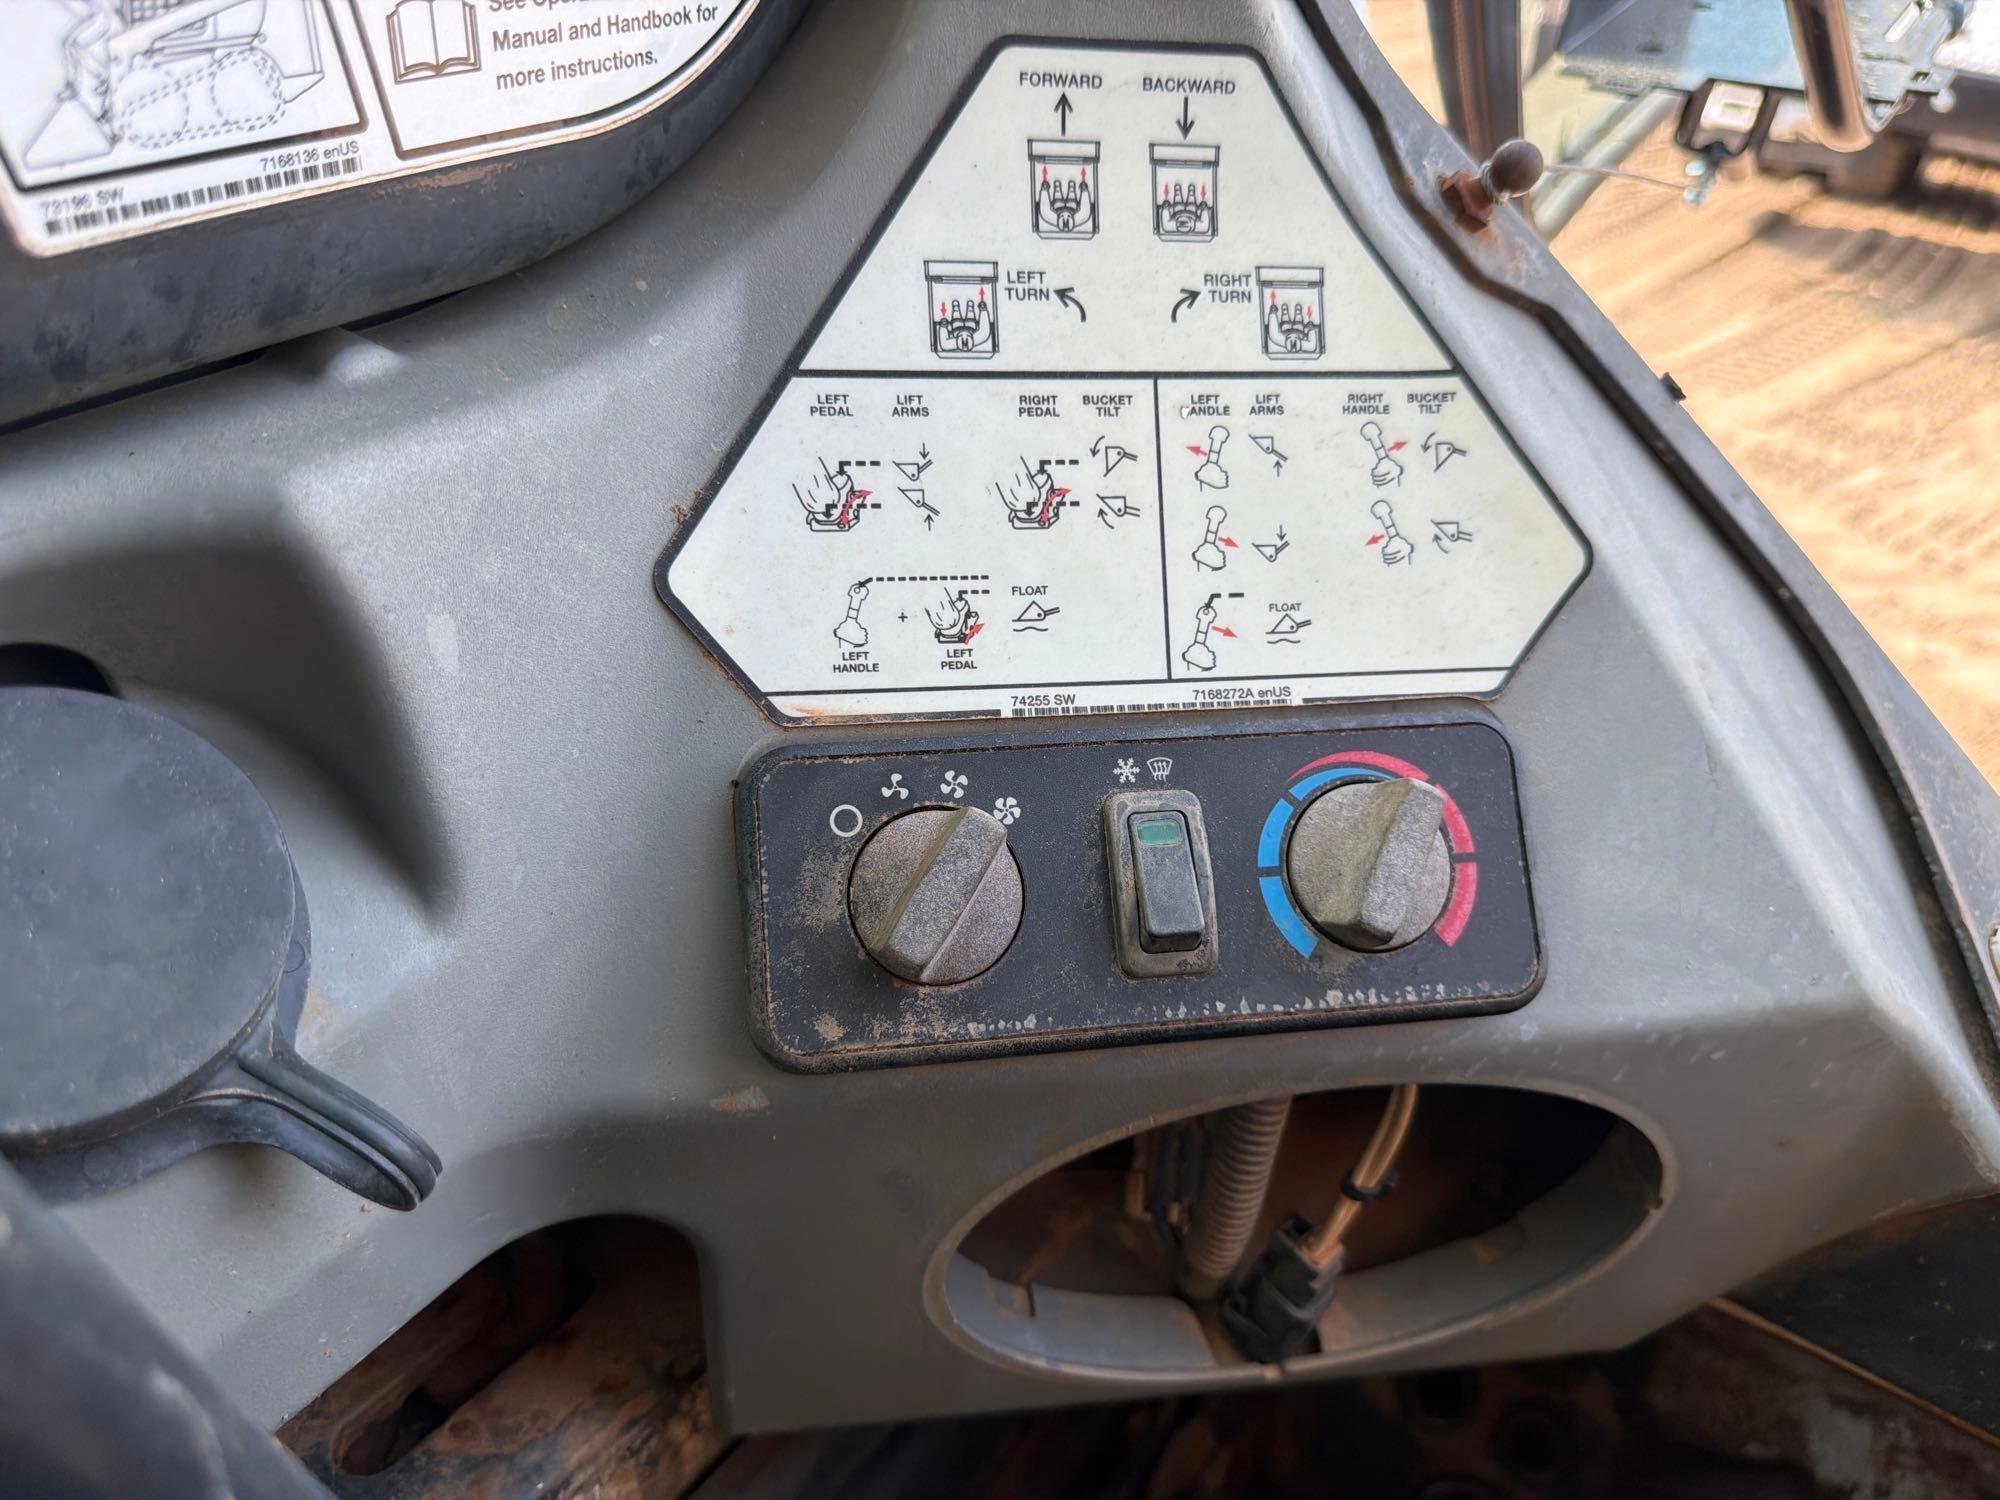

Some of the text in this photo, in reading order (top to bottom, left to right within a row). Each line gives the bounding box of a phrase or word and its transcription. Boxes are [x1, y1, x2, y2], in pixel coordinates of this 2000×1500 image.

[492, 4, 718, 52] Manual and Handbook for
[496, 49, 659, 90] more instructions.
[1019, 72, 1103, 89] FORWARD
[1142, 77, 1235, 95] BACKWARD
[260, 140, 359, 171] 7168136 enUS
[1007, 271, 1046, 284] LEFT
[1204, 274, 1251, 287] RIGHT
[1005, 287, 1050, 301] TURN
[1208, 290, 1251, 303] TURN
[817, 394, 849, 405] LEFT
[897, 395, 923, 405] LIFT
[1019, 395, 1058, 406] RIGHT
[1082, 395, 1133, 406] BUCKET
[1191, 394, 1220, 404] LEFT
[1256, 394, 1280, 404] LIFT
[1347, 394, 1384, 404] RIGHT
[1407, 393, 1456, 404] BUCKET
[810, 406, 854, 417] PEDAL
[892, 406, 930, 418] ARMS
[1019, 407, 1060, 418] PEDAL
[1096, 406, 1121, 417] TILT
[1180, 406, 1230, 417] ANDLE
[1249, 406, 1284, 416] ARMS
[1342, 405, 1390, 415] HANDLE
[1419, 404, 1442, 414] TILT
[1012, 586, 1048, 596] FLOAT
[1269, 602, 1301, 612] FLOAT
[842, 652, 869, 661] LEFT
[947, 648, 974, 658] LEFT
[833, 663, 880, 674] HANDLE
[941, 660, 977, 670] PEDAL
[1192, 686, 1292, 701] 7168272A enUS
[1011, 694, 1076, 707] 74255 SW
